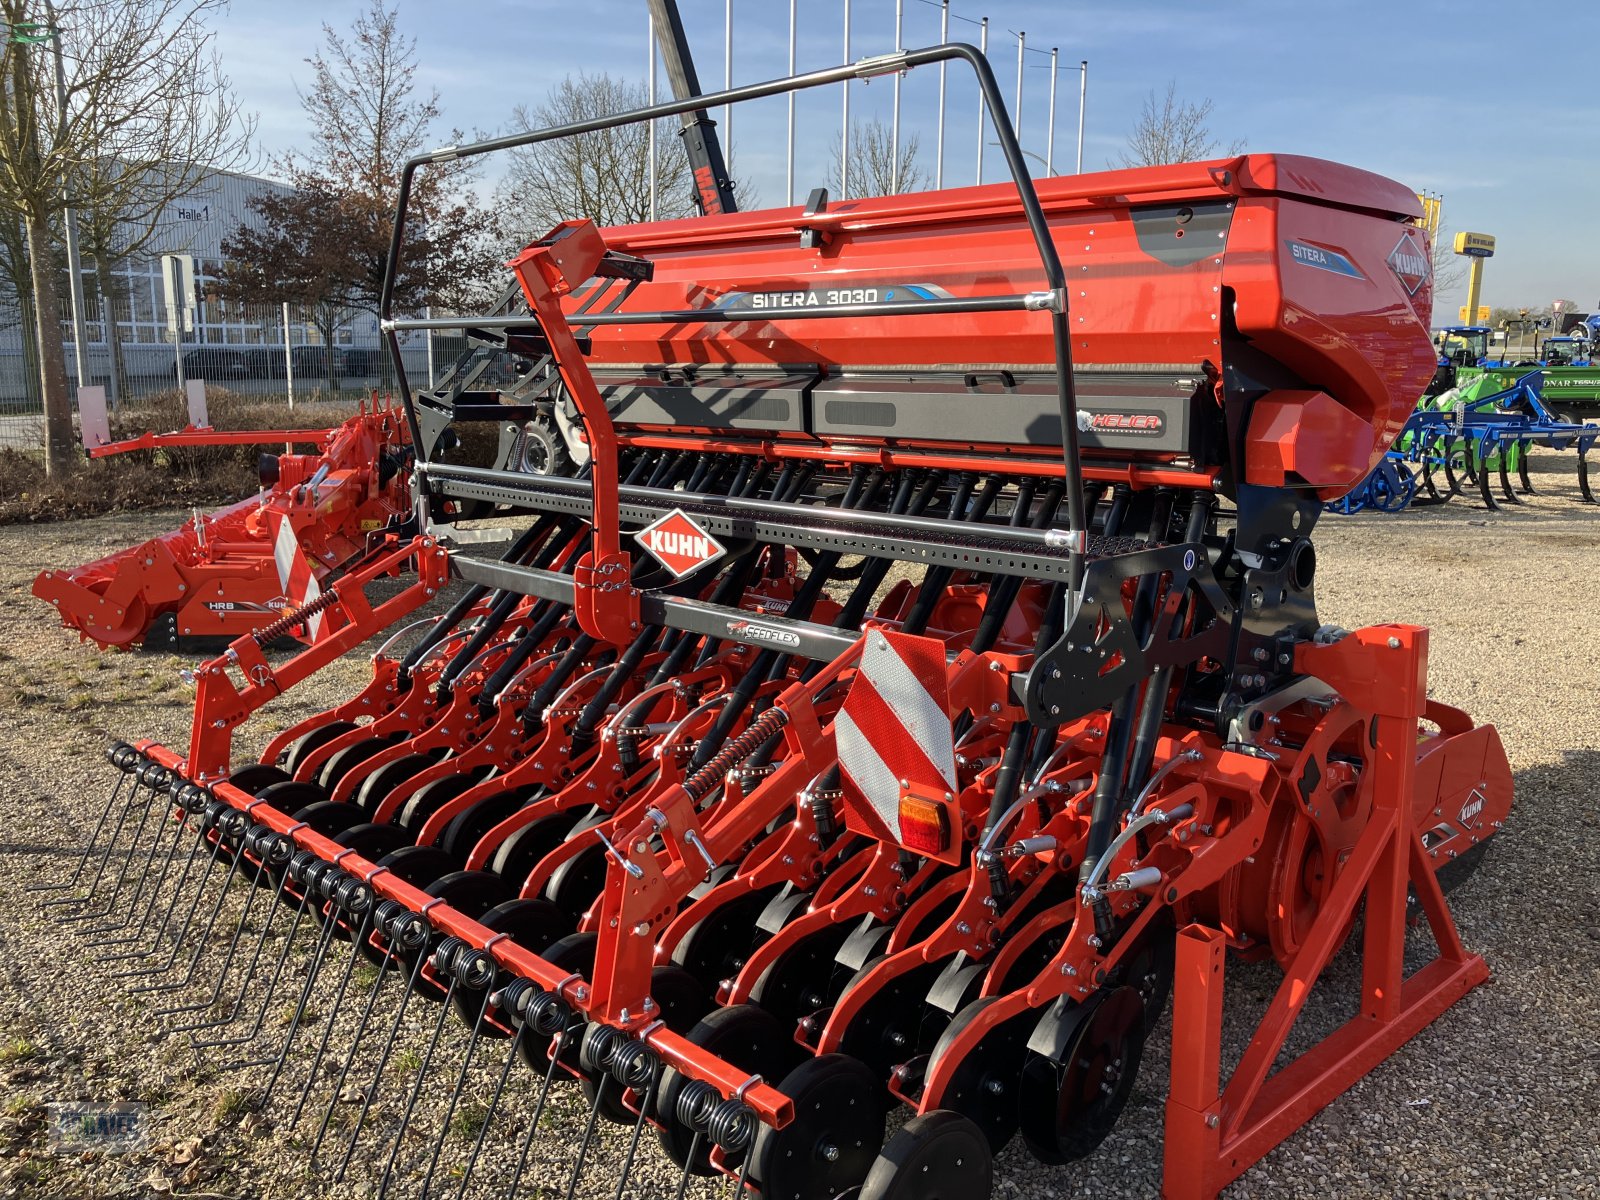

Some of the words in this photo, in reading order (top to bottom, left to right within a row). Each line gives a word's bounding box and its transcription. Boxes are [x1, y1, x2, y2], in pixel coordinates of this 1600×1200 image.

[178, 208, 201, 221] Halle
[203, 205, 209, 221] 1
[1292, 244, 1327, 264] SITERA
[1395, 253, 1426, 277] KUHN
[752, 292, 819, 308] SITERA
[827, 289, 878, 304] 3030
[1543, 380, 1571, 388] ONAR
[1092, 413, 1159, 429] HELICA
[650, 529, 709, 560] KUHN
[209, 602, 234, 610] HRB
[764, 601, 790, 612] KUHN
[748, 626, 797, 643] SEEDFLEX
[1461, 798, 1483, 821] KUHN
